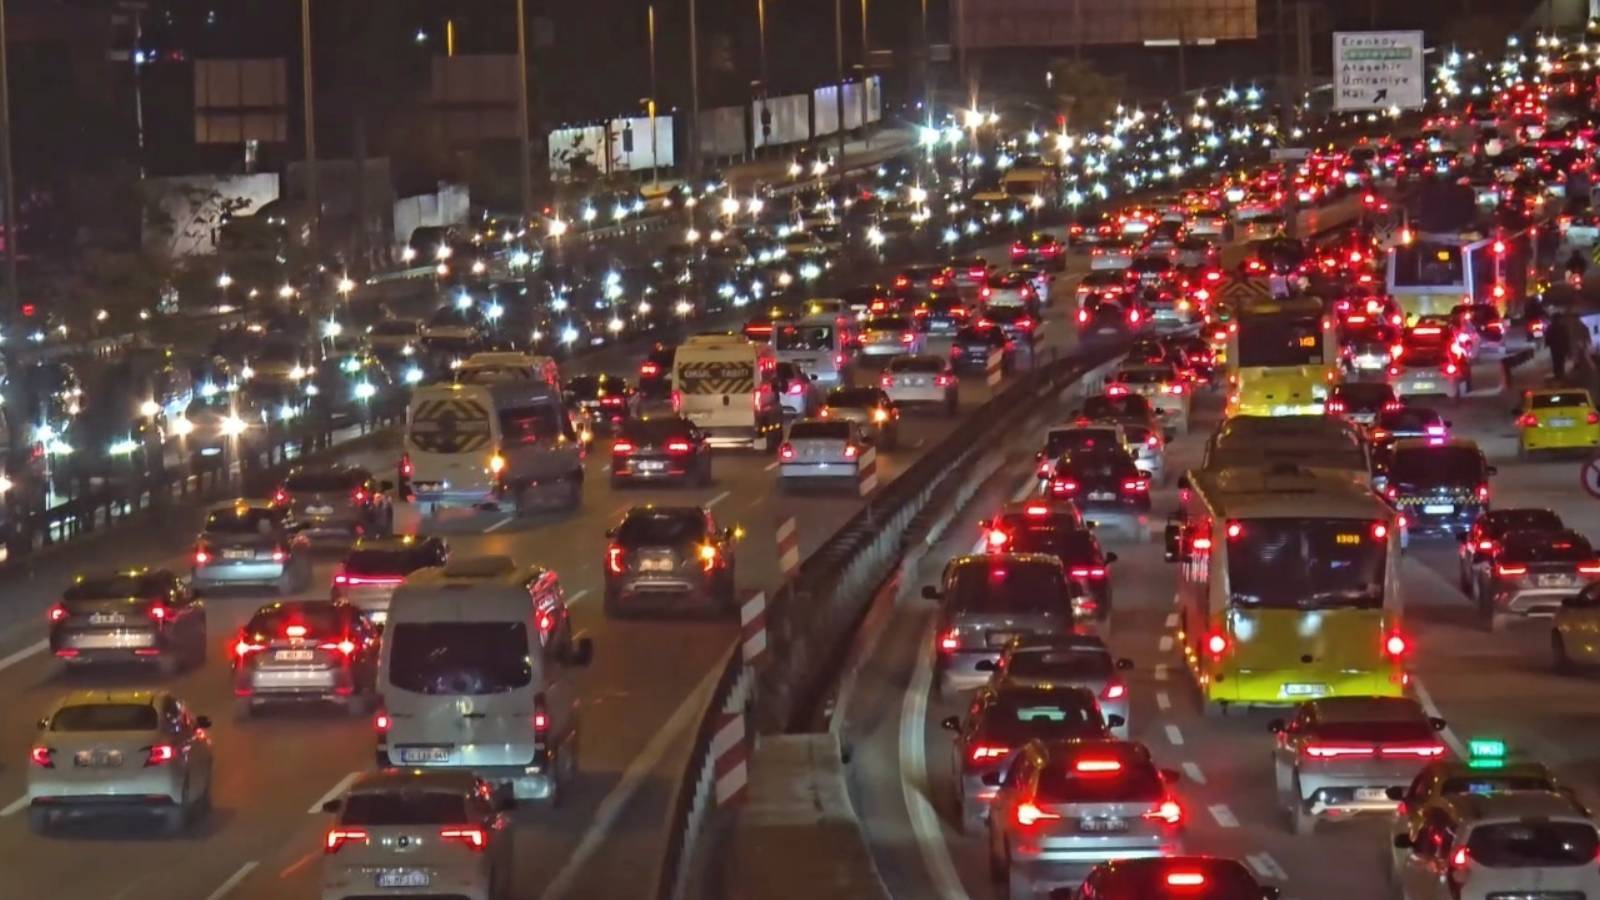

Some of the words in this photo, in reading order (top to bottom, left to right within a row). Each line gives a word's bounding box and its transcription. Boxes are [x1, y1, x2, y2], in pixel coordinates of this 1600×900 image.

[1342, 37, 1397, 47] Erenköy
[1343, 63, 1402, 73] Ataşehir
[1342, 75, 1408, 86] Ümraniye
